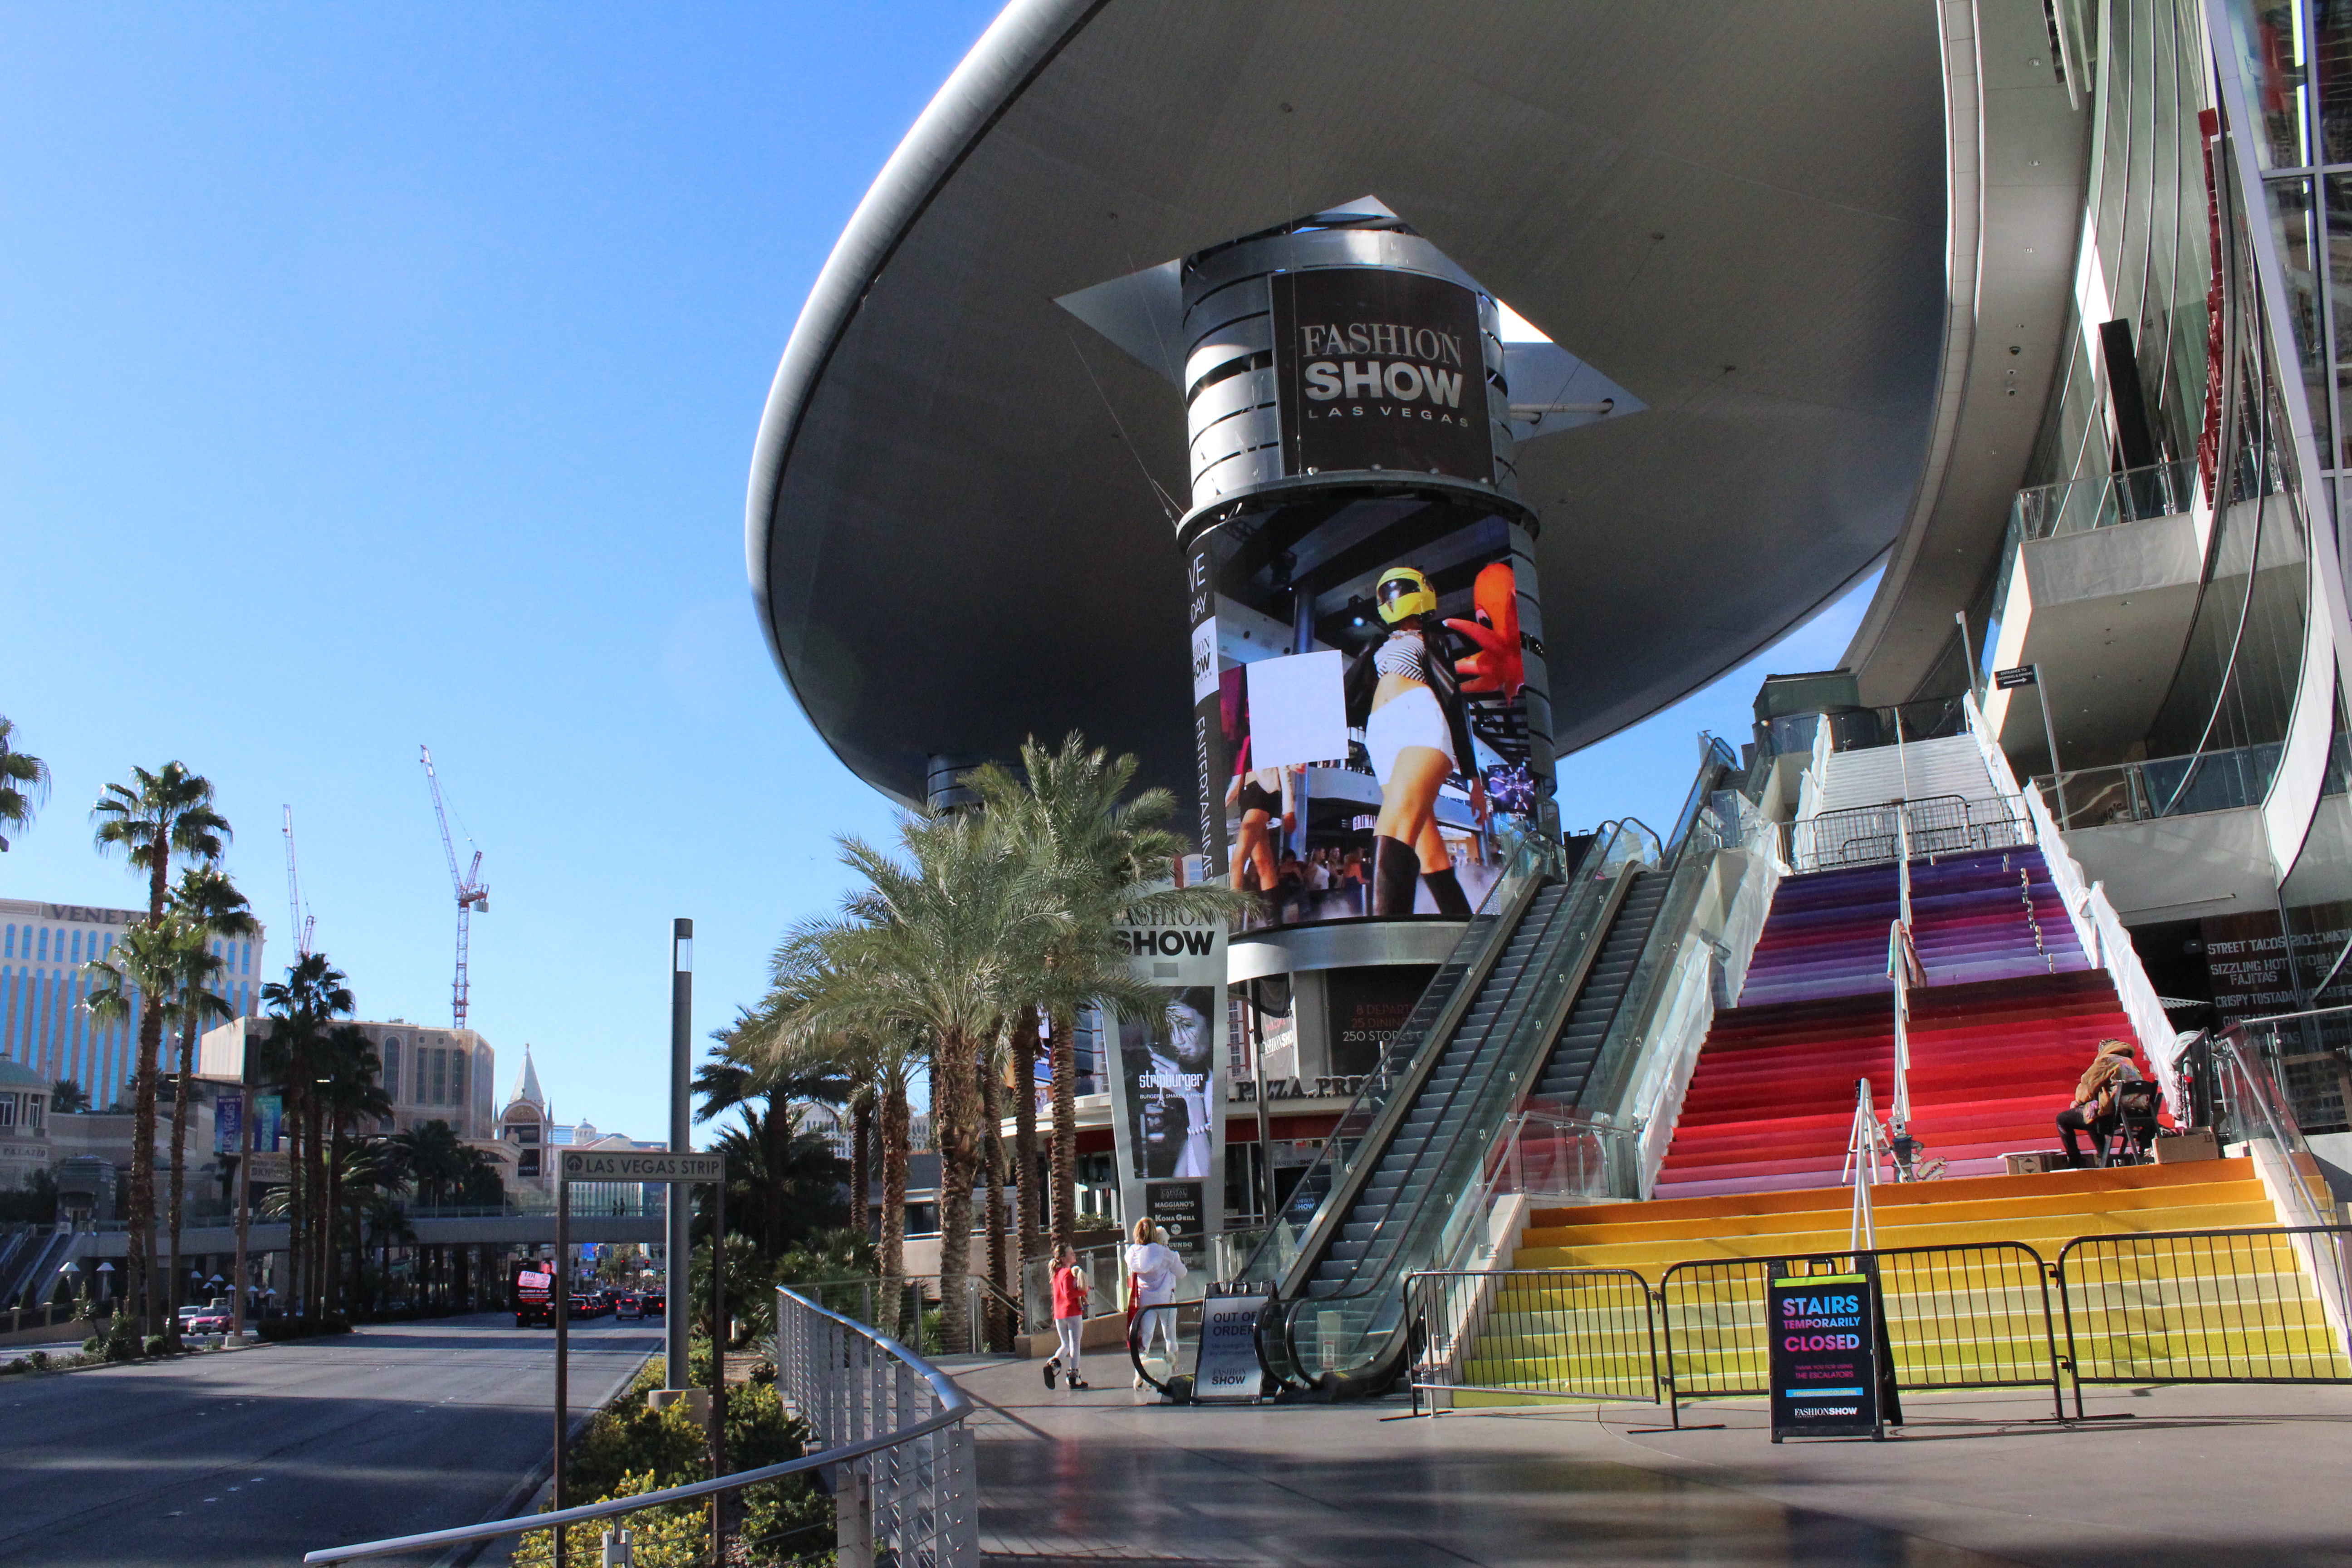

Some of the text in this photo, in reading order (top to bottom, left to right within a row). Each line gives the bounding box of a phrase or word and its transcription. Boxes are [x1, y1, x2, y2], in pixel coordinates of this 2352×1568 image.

[1300, 323, 1463, 368] FASHION
[1305, 361, 1463, 408] SHOW
[1308, 406, 1469, 428] LAS VEGAS
[1114, 930, 1215, 956] SHOW
[2207, 940, 2246, 955] STREET
[2248, 936, 2286, 951] TACOS
[2210, 960, 2261, 975] SIZZLING
[2264, 958, 2288, 970] HOT
[2230, 970, 2278, 985] FAJITAS
[2215, 994, 2248, 1009] CRISPY
[1343, 1031, 1366, 1041] 250
[1139, 1069, 1204, 1091] stripburger
[586, 1158, 720, 1175] LAS VEGAS STRIP
[1783, 1295, 1859, 1316] STAIRS
[1213, 1312, 1257, 1323] OUT OF
[1783, 1316, 1860, 1330] TEMPORARILY
[1213, 1325, 1255, 1336] ORDER
[1784, 1333, 1860, 1352] CLOSED
[1211, 1375, 1246, 1385] SHOW
[1809, 1370, 1854, 1379] ESCALATORS
